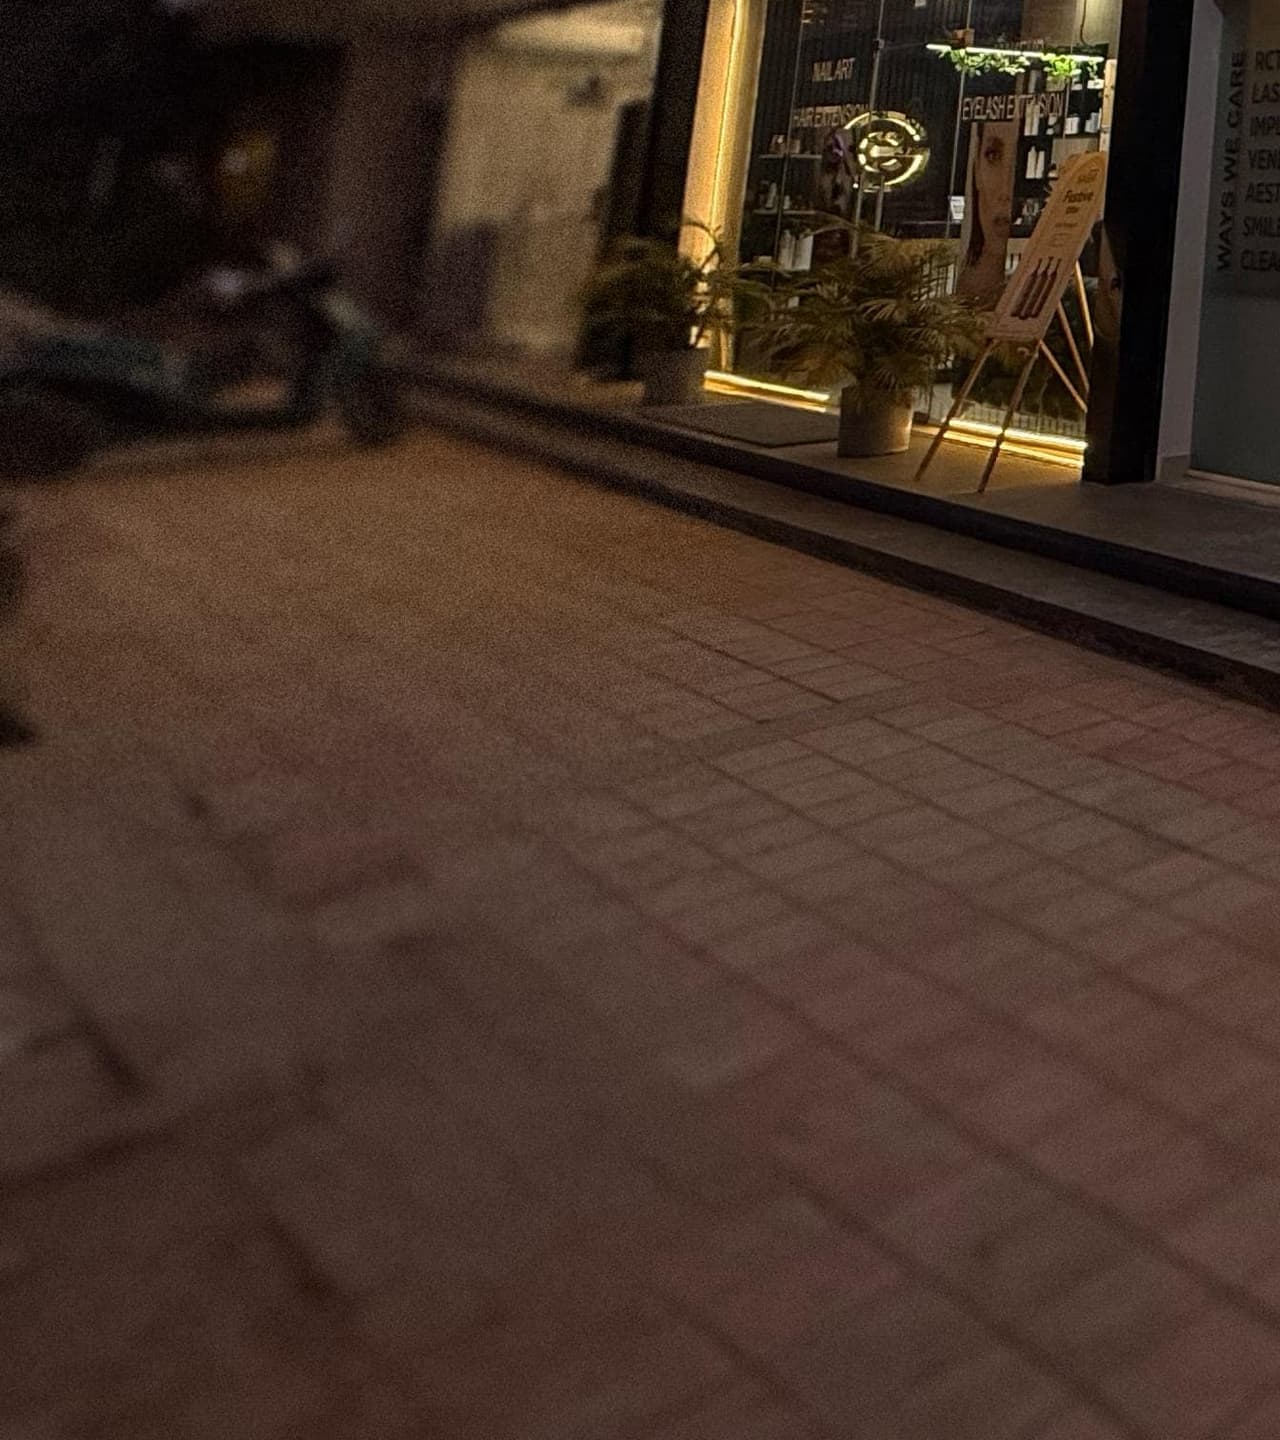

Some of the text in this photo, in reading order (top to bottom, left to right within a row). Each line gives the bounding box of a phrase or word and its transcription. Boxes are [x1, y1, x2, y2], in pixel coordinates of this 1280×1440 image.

[963, 95, 1006, 120] EYELASH
[1217, 51, 1246, 271] WAYS WE CARE
